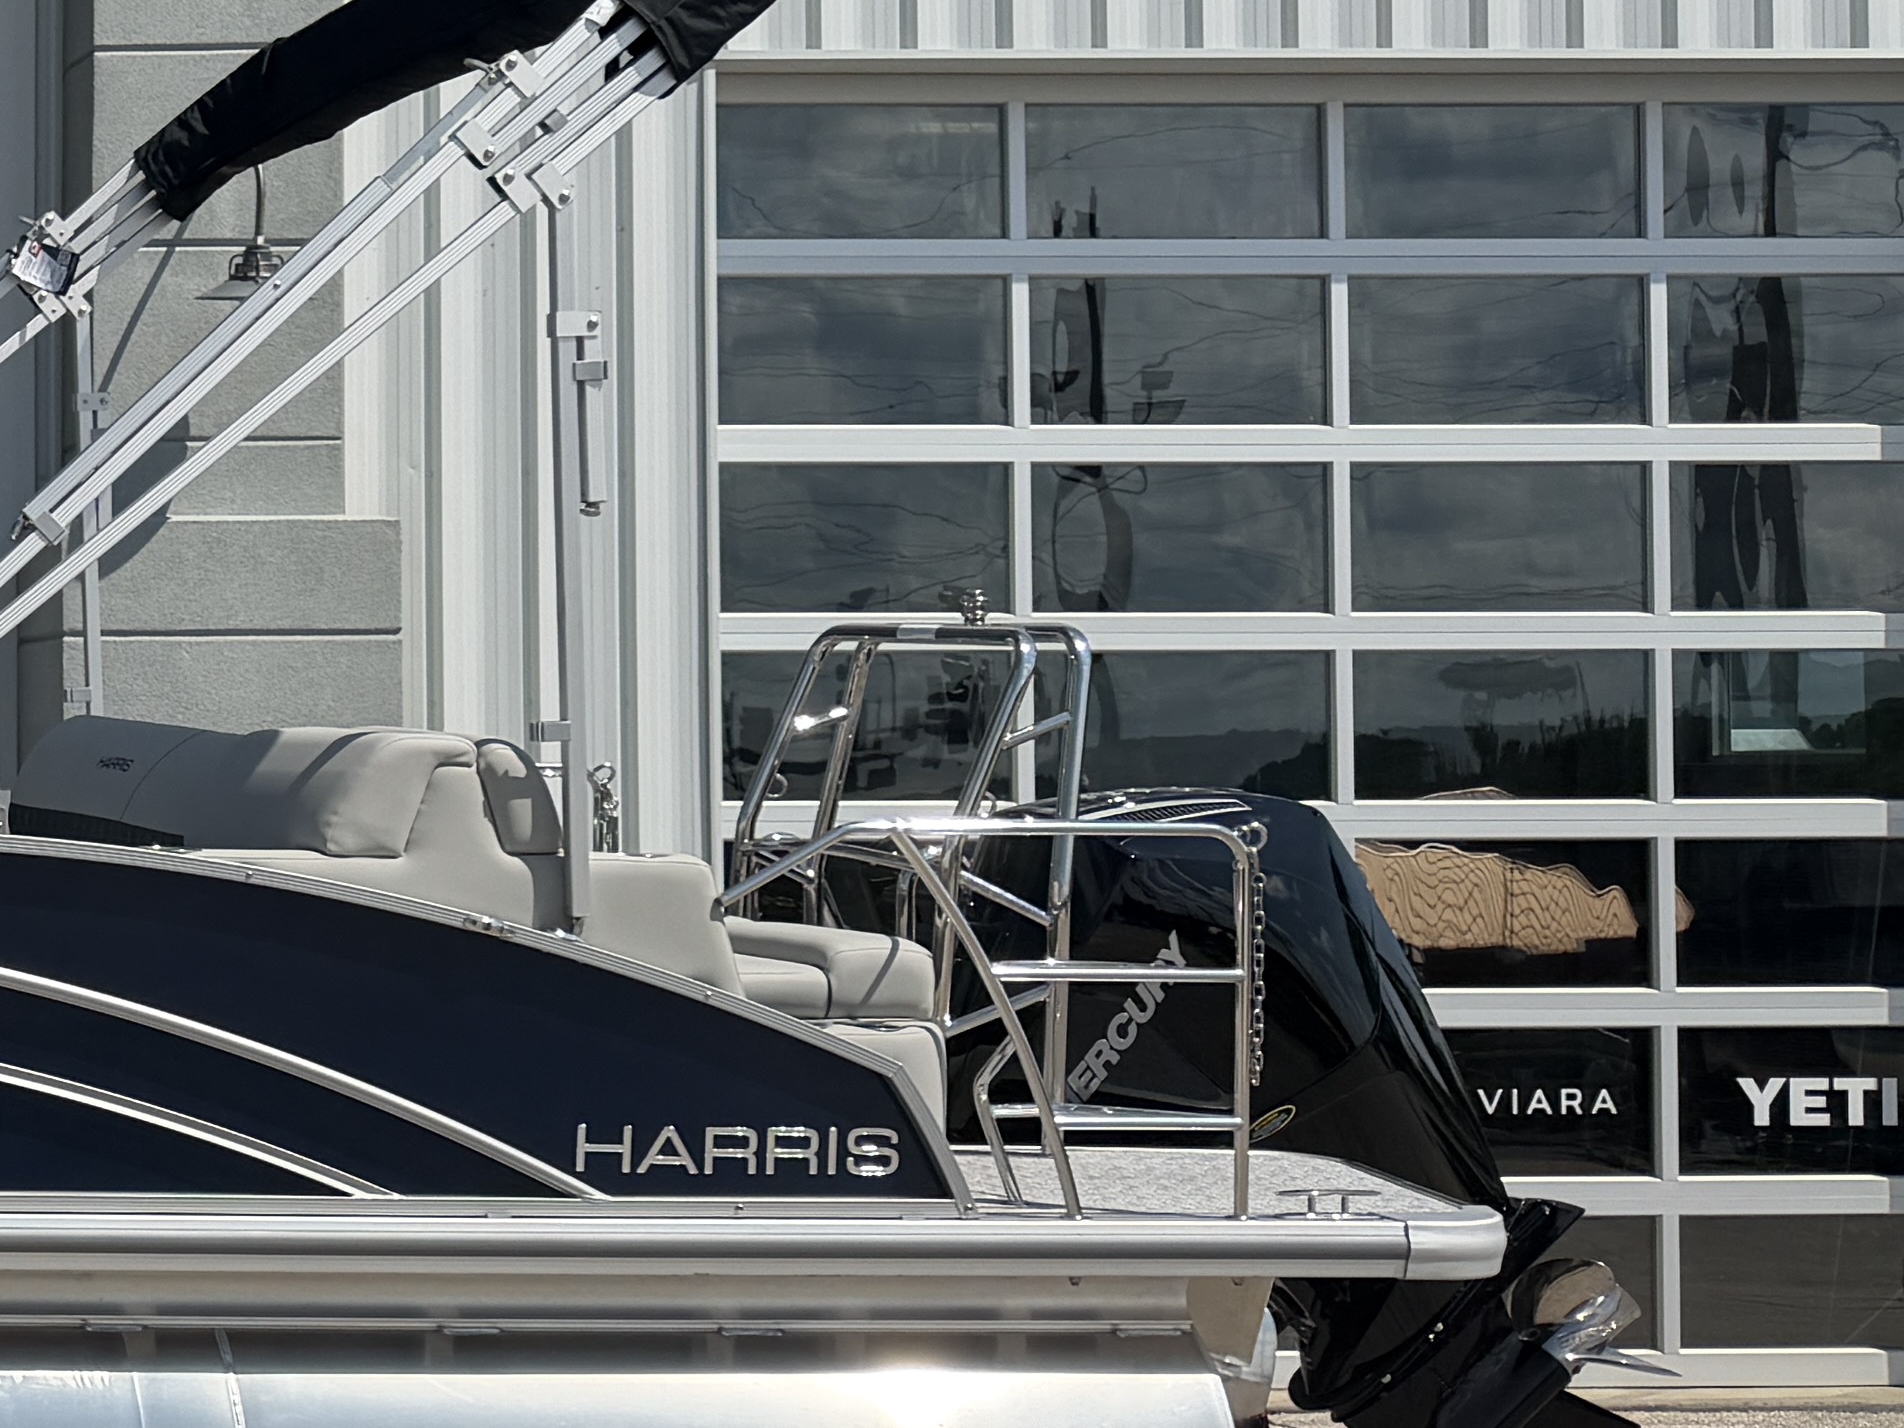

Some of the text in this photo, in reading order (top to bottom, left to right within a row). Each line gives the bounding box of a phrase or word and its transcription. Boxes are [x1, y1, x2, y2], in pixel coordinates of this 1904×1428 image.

[1477, 1088, 1618, 1115] VIARA
[1735, 1077, 1899, 1126] YETI
[576, 1123, 900, 1177] HARRIS
